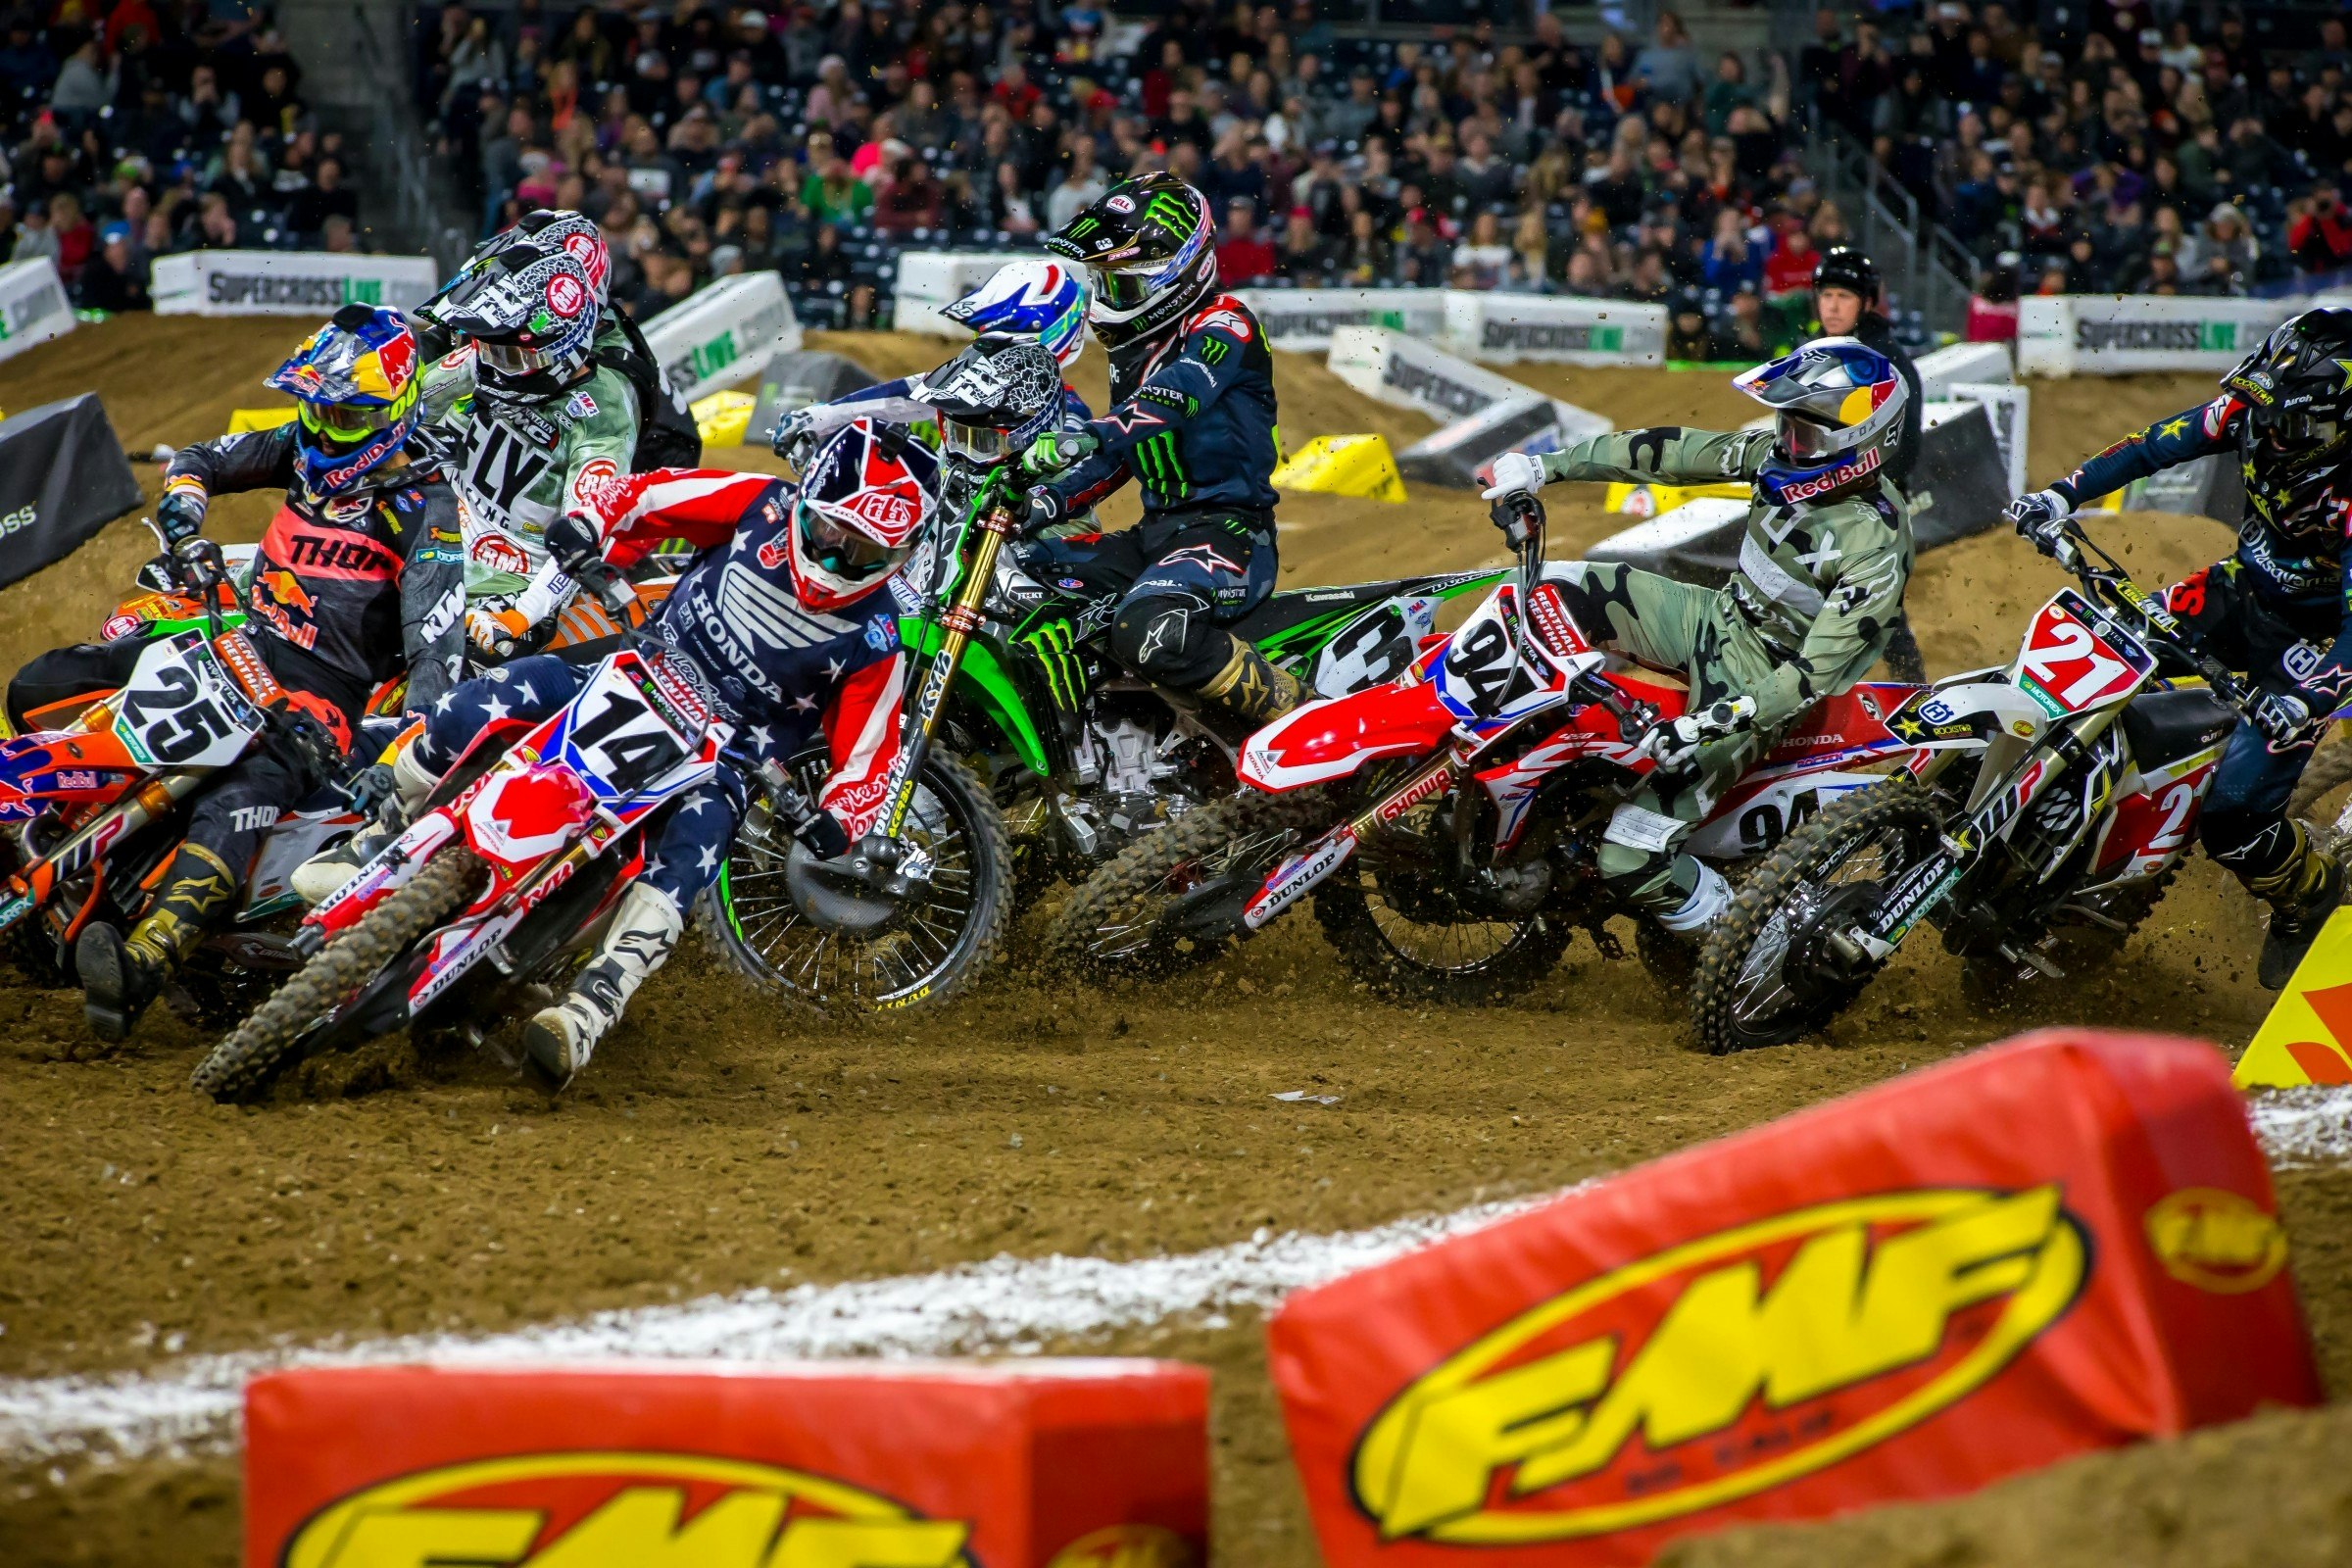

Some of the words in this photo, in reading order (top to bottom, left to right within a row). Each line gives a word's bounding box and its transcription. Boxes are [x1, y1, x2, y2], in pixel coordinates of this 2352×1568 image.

[1149, 283, 1196, 321] MONSTER
[1179, 357, 1218, 389] awasaki
[1847, 418, 1878, 442] FOX
[323, 454, 371, 490] Red
[1780, 471, 1836, 505] Red
[1835, 445, 1882, 486] Bull
[833, 507, 881, 541] HONDA
[419, 580, 466, 644] KTM
[1304, 590, 1355, 603] Kawasaki
[1535, 590, 1578, 657] RENTHAL
[692, 590, 783, 705] HONDA
[1331, 605, 1414, 695] 3
[1444, 618, 1539, 722] 94
[2023, 622, 2129, 710] 21
[121, 665, 234, 763] 25
[650, 688, 687, 730] MONSTER
[2030, 685, 2063, 717] MOTOREX
[567, 690, 686, 794] 14
[1246, 751, 1266, 781] HONDA
[1782, 733, 1844, 749] HONDA
[872, 745, 911, 837] DUNLOP
[1383, 768, 1452, 823] SHOWA
[1268, 852, 1337, 908] DUNLOP
[1879, 857, 1947, 933] DUNLOP
[1905, 870, 1961, 927] MOTOREX
[431, 927, 503, 995] DUNLOP
[1380, 1184, 2064, 1540] FMF
